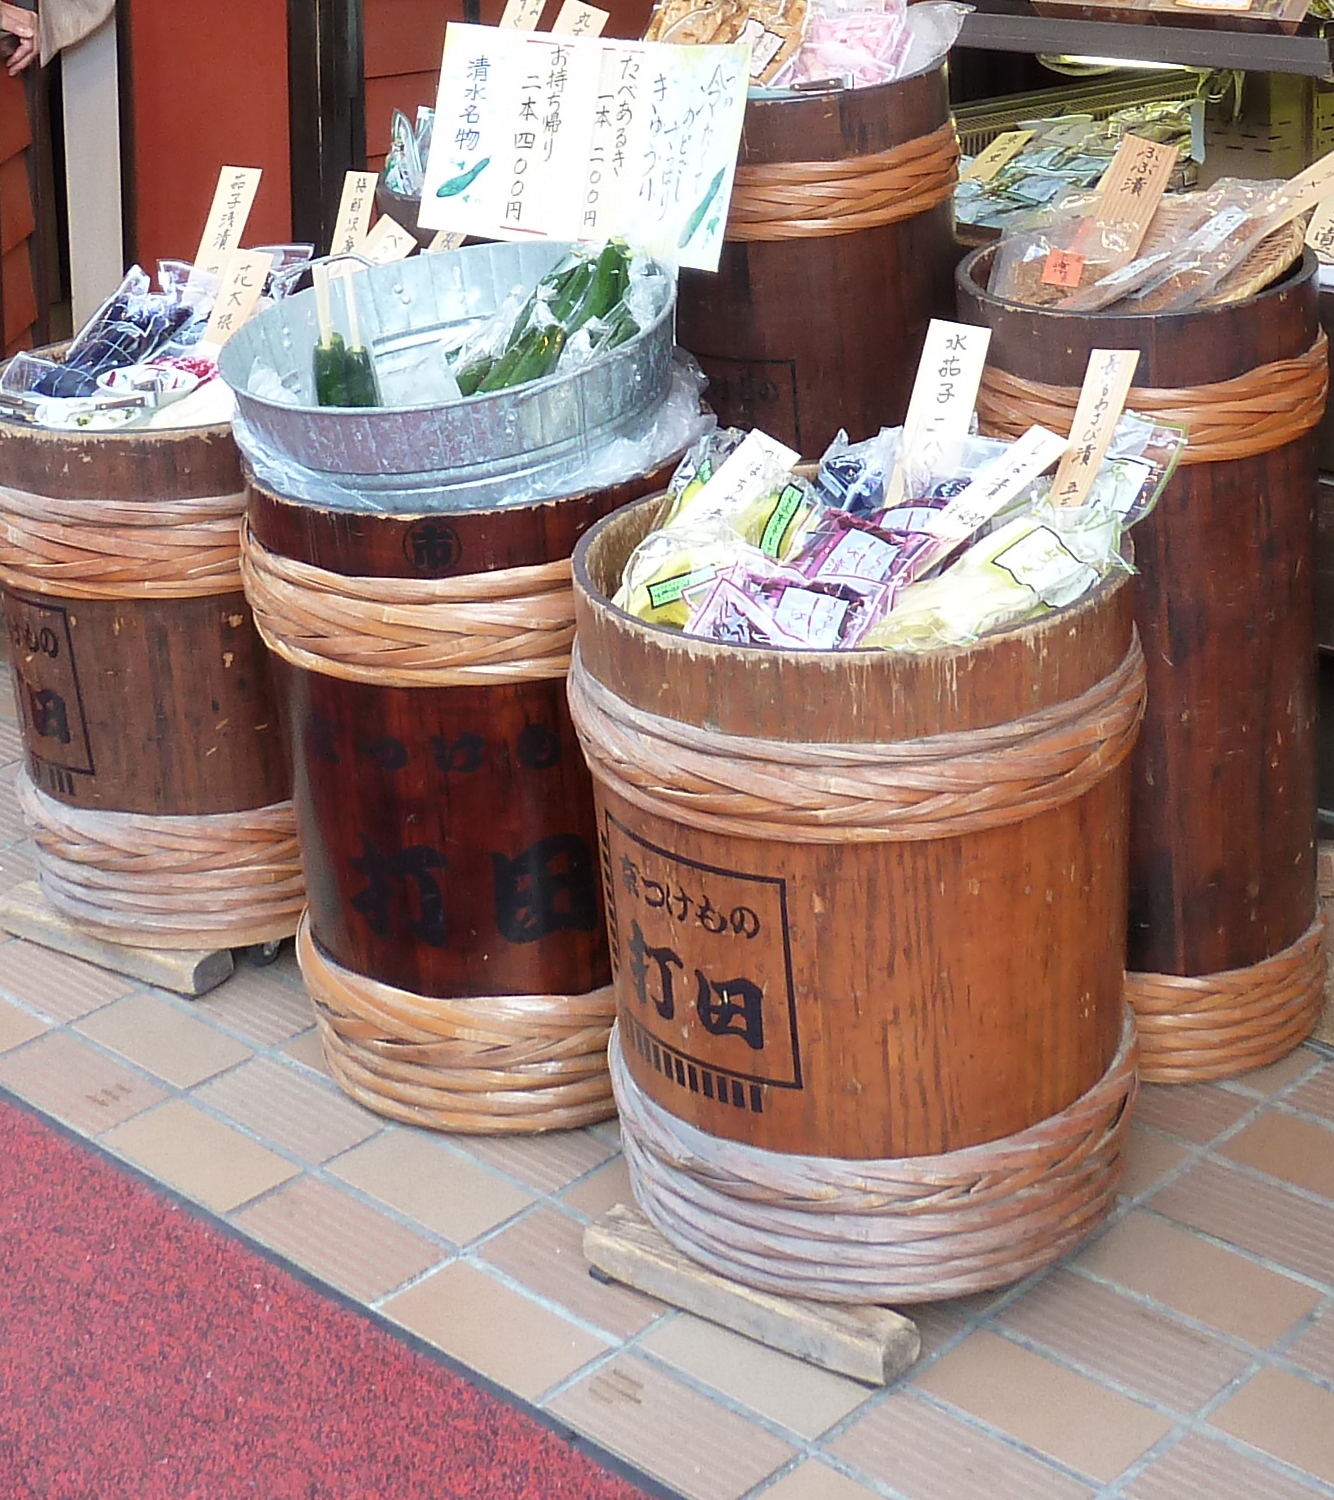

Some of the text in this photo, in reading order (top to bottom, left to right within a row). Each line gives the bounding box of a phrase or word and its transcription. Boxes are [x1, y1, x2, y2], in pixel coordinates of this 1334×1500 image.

[454, 54, 492, 151] 清水名物
[542, 45, 570, 163] お持ち帰り
[611, 54, 640, 178] たべあるき
[638, 72, 667, 203] きゅうり
[211, 172, 247, 250] 茄子浅漬
[216, 264, 255, 333] 花大根
[935, 333, 967, 404] 水茄子
[348, 831, 599, 948] 打田
[619, 853, 761, 940] 京つけもの
[627, 918, 765, 1051] 打田
